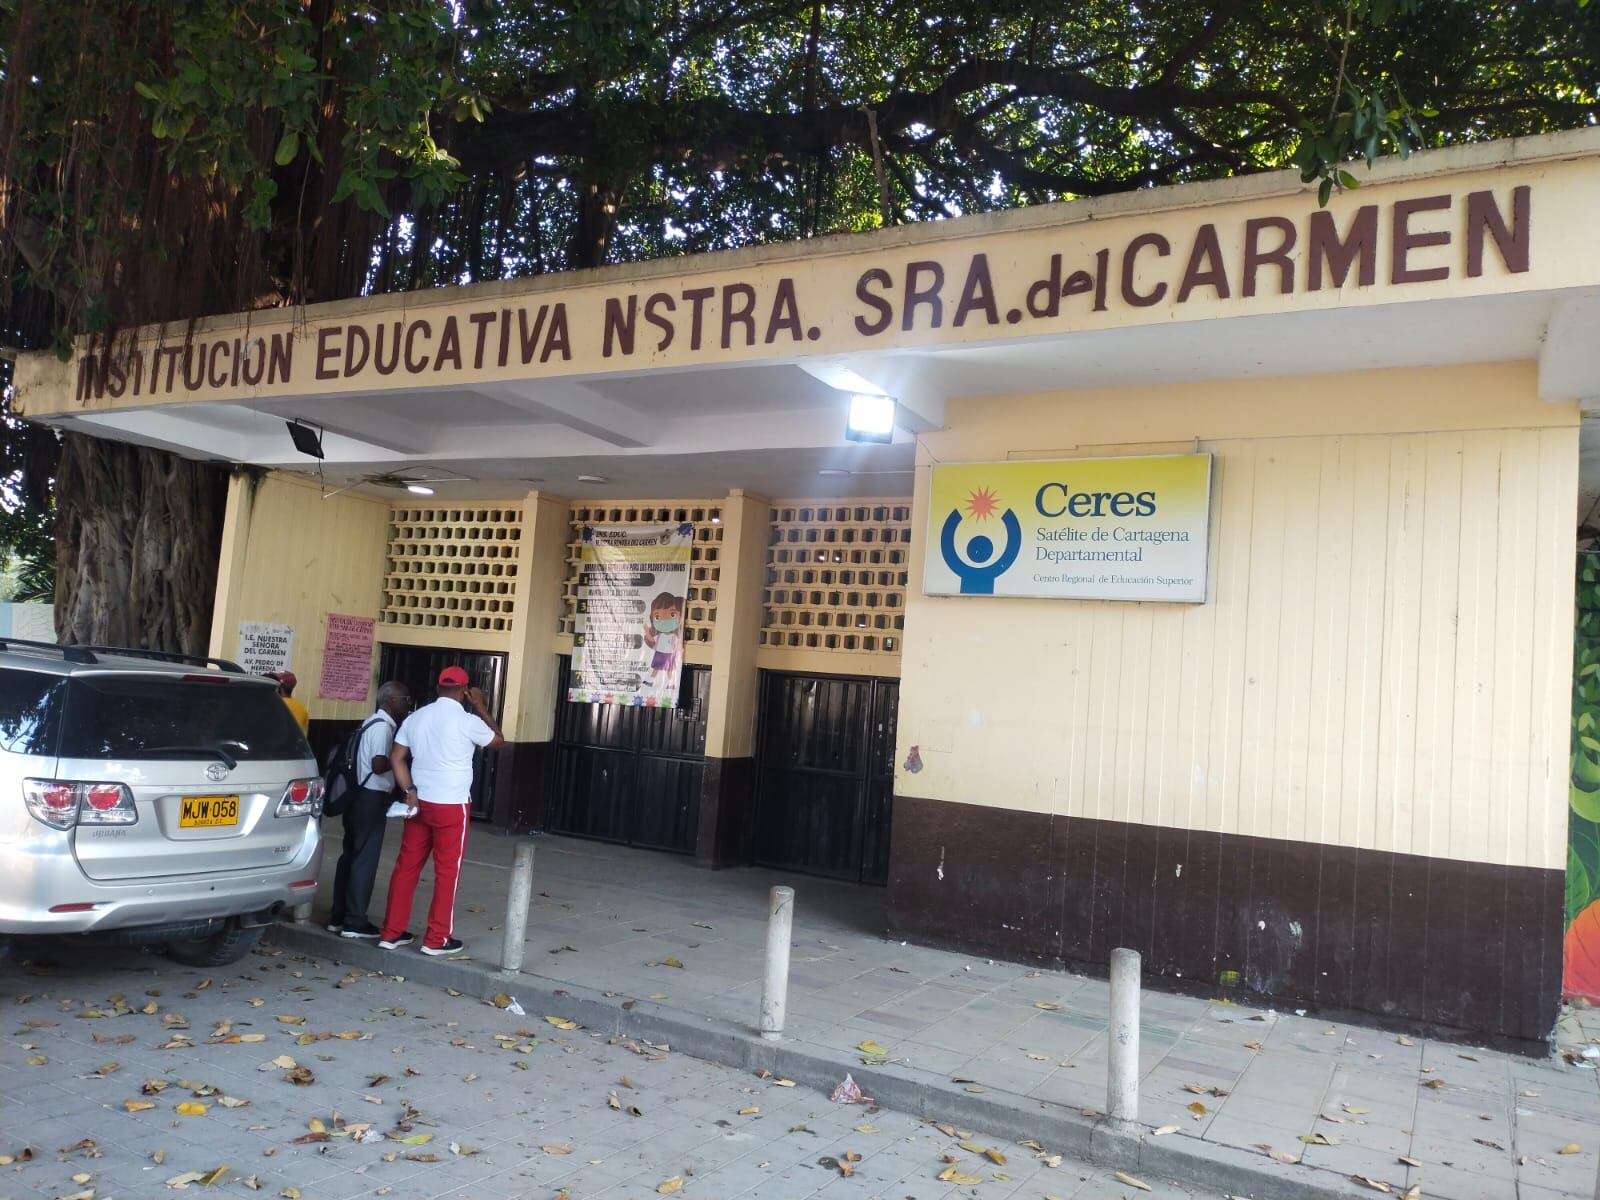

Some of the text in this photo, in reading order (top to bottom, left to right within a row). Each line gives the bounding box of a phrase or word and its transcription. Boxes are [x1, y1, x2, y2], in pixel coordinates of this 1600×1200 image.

[75, 185, 1531, 401] INSTITUCION EDUCATIVA NSTRA. SRA. del CARMEN
[1035, 482, 1156, 518] Ceres
[1036, 527, 1189, 545] Satélite de Cartagena
[1035, 546, 1143, 564] Departamental
[1033, 573, 1060, 583] Centro
[1061, 574, 1095, 585] Regional
[1098, 575, 1109, 583] de
[1156, 575, 1194, 587] Superior
[257, 635, 288, 643] NUESTRA
[258, 648, 286, 656] CARMEN
[183, 801, 236, 819] MJW 058
